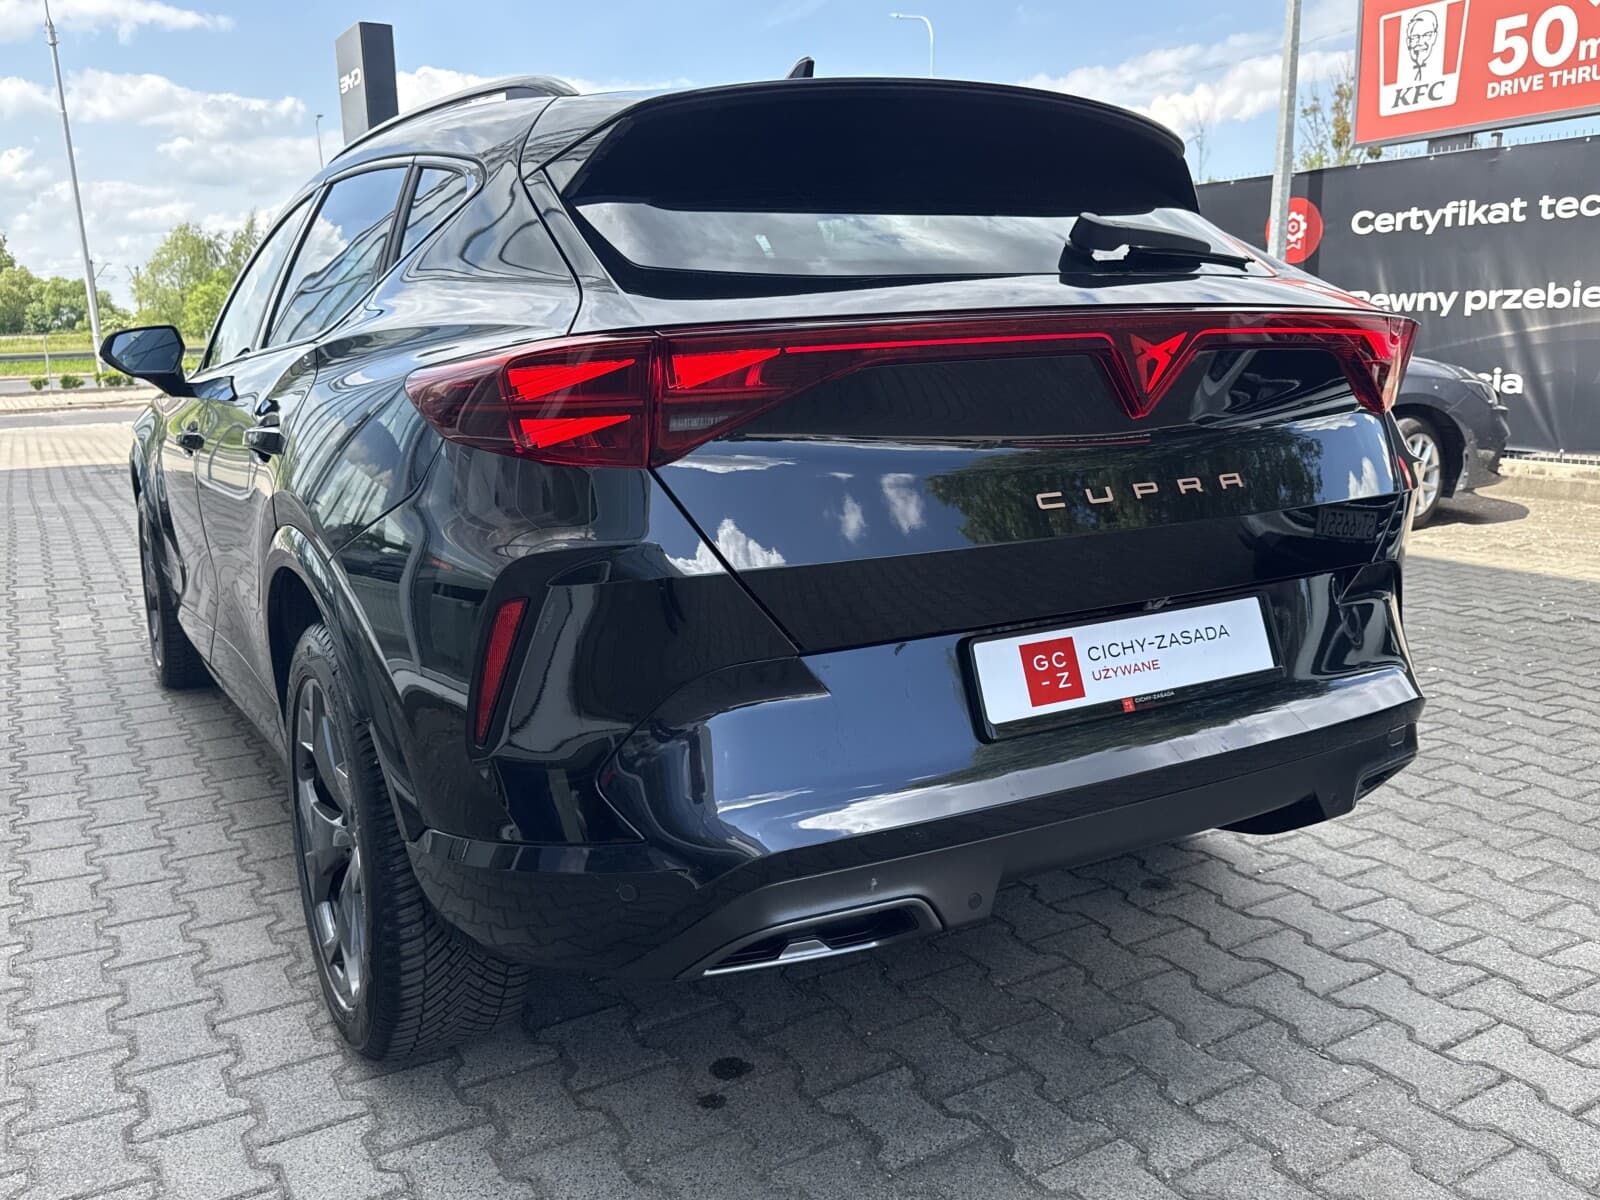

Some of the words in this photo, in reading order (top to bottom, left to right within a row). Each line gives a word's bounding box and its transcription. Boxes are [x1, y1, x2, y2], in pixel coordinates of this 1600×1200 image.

[1391, 80, 1446, 109] KFC
[1486, 73, 1544, 99] DRIVE
[1351, 197, 1527, 235] Certyfikat
[1539, 194, 1600, 220] tec
[1464, 279, 1600, 316] przebie
[1036, 472, 1244, 510] CUPRA
[1087, 624, 1230, 661] CICHY-ZASADA
[1033, 651, 1067, 671] GC
[1092, 659, 1160, 681] UŻYWANE
